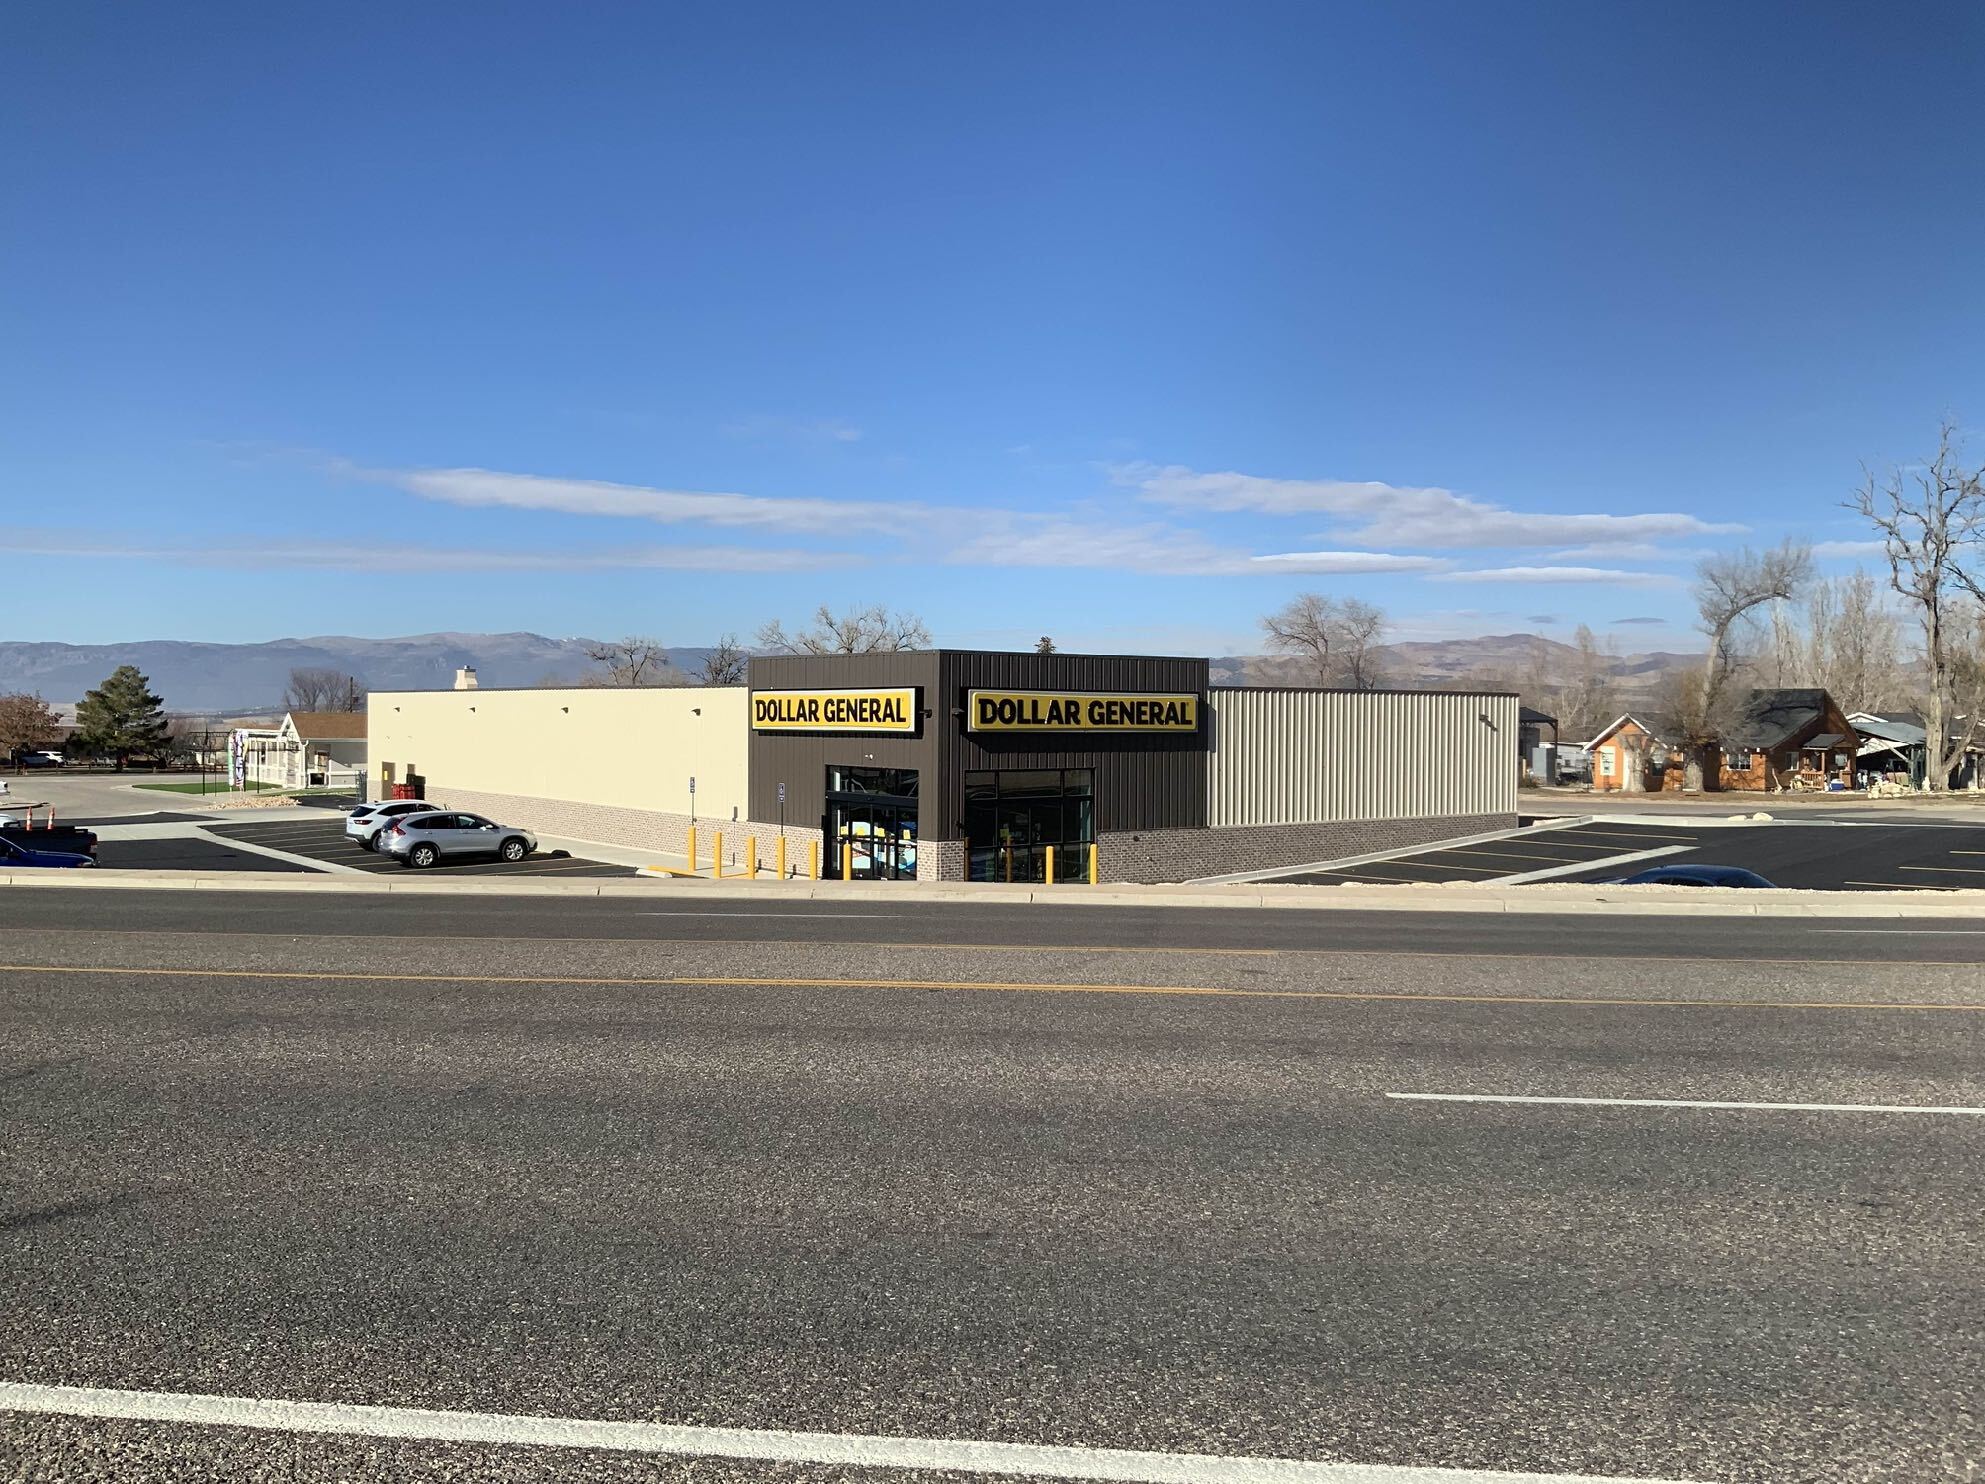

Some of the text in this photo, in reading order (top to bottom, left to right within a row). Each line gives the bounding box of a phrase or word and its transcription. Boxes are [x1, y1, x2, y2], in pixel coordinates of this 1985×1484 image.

[755, 697, 907, 723] DOLLAR GENERAL
[978, 698, 1193, 726] DOLLAR GENERAL
